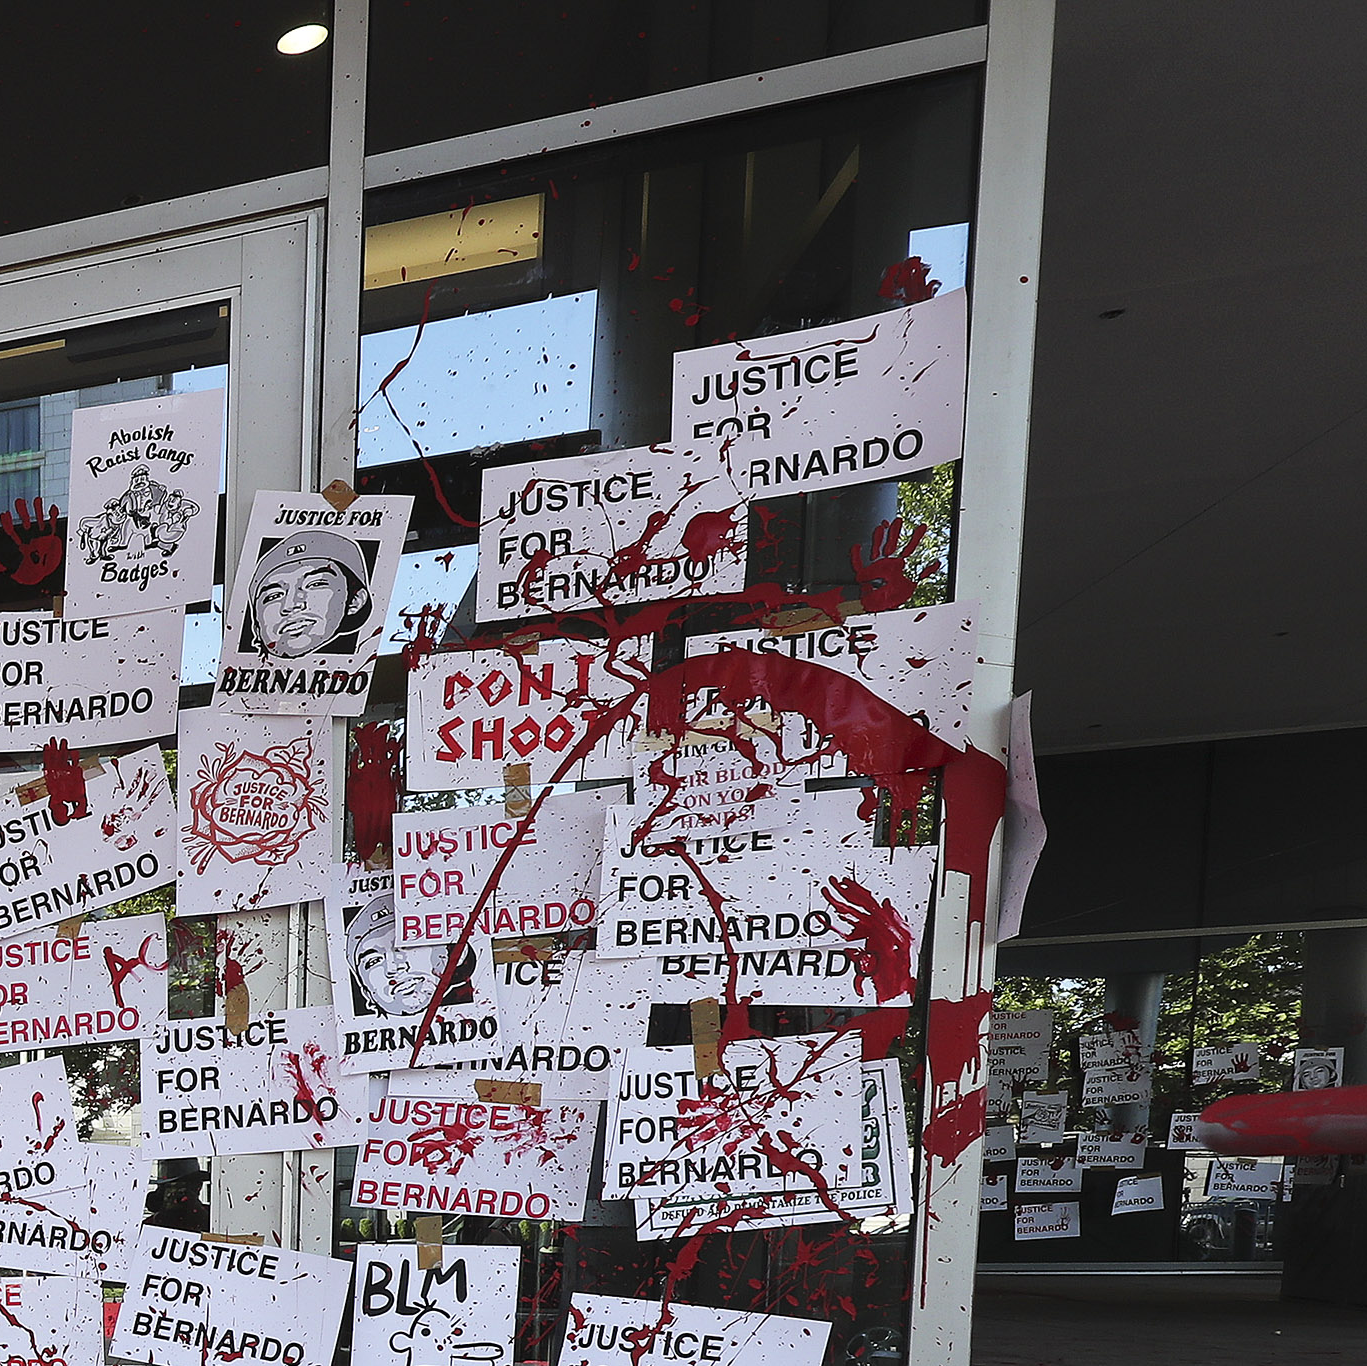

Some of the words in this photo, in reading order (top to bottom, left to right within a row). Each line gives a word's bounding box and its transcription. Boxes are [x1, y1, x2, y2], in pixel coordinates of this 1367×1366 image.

[691, 347, 859, 406] JUSTICE
[109, 424, 175, 451] Abolish
[85, 445, 140, 478] Racist
[143, 443, 195, 473] Gangs
[500, 471, 654, 521] JUSTICE
[274, 508, 345, 527] JUSTICE
[347, 509, 384, 527] FOR
[101, 560, 169, 592] Badges
[219, 667, 368, 697] BERNARDO
[232, 781, 288, 802] JUSTICE
[238, 794, 275, 810] FOR
[218, 805, 289, 830] BERNARDO
[399, 871, 465, 899] FOR
[618, 874, 691, 903] FOR
[1195, 1046, 1233, 1057] JUSTICE
[1195, 1058, 1214, 1069] FOR
[157, 1066, 221, 1093] FOR
[1085, 1073, 1123, 1085] JUSTICE
[1084, 1092, 1140, 1106] BERNARDO
[1085, 1085, 1104, 1096] FOR
[157, 1096, 340, 1135] BERNARDO
[618, 1116, 678, 1145] FOR
[1080, 1143, 1102, 1154] FOR
[1079, 1153, 1136, 1165] BERNARDO
[1215, 1160, 1258, 1172] JUSTICE
[1020, 1167, 1040, 1178] FOR
[1215, 1171, 1235, 1182] FOR
[1019, 1177, 1074, 1188] BERNARDO
[1212, 1182, 1268, 1193] BERNARDO
[357, 1180, 552, 1219] BERNARDO
[840, 1187, 883, 1203] POLICE
[1018, 1204, 1054, 1214] JUSTICE
[1016, 1215, 1035, 1226] FOR
[1016, 1223, 1070, 1235] BERNARDO
[151, 1237, 280, 1282] JUSTICE
[141, 1274, 205, 1308] FOR
[362, 1258, 468, 1317] BLM
